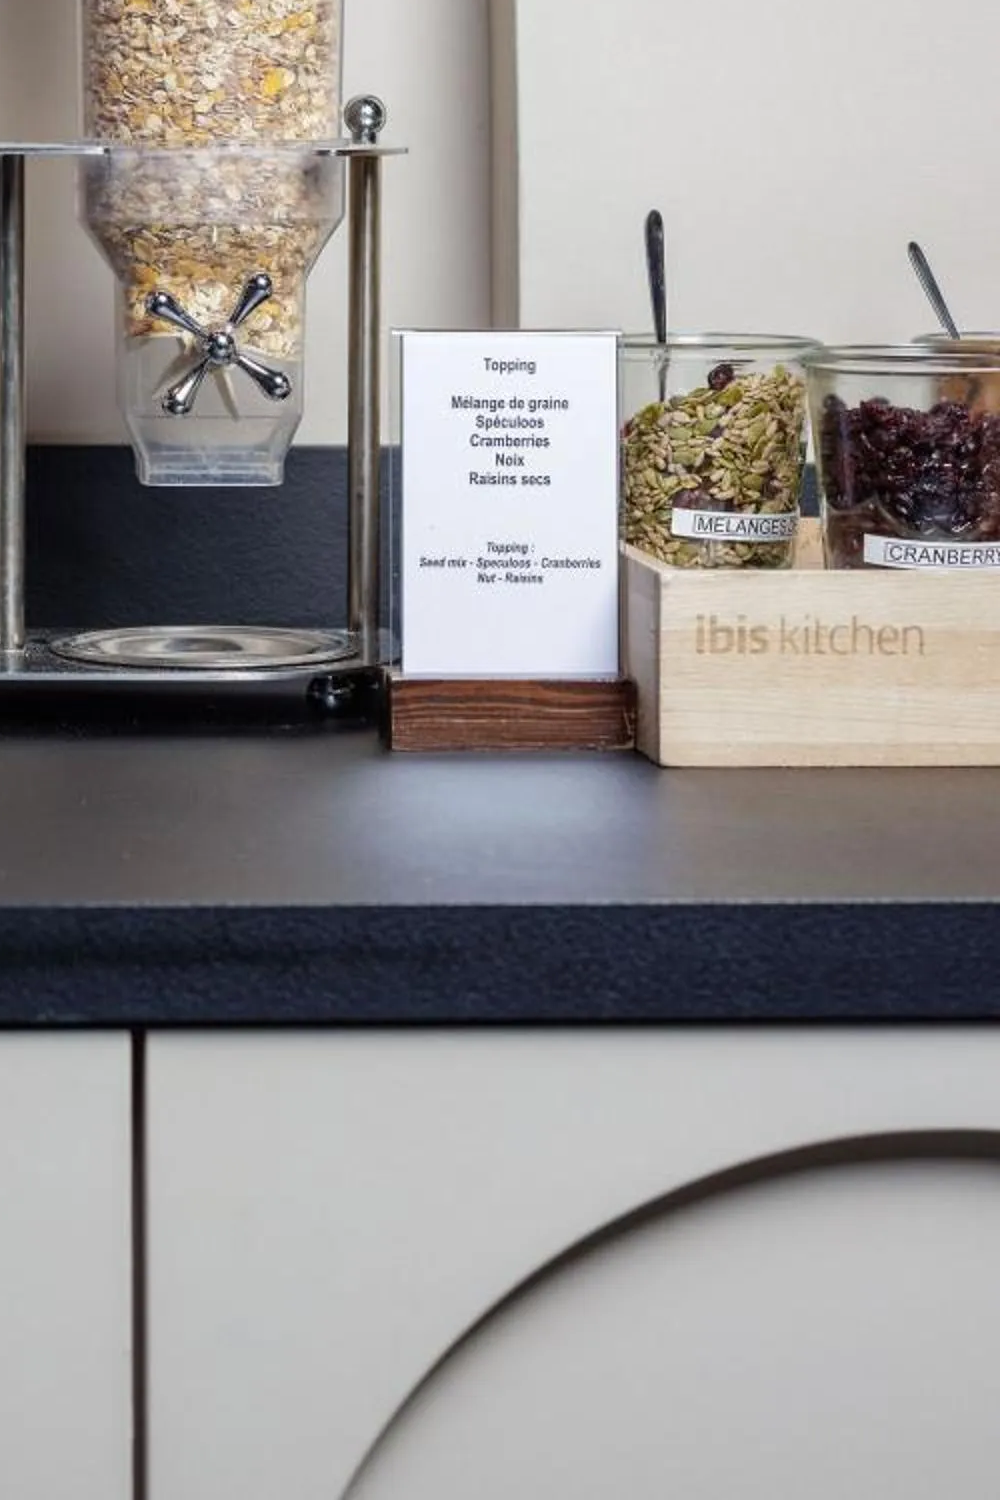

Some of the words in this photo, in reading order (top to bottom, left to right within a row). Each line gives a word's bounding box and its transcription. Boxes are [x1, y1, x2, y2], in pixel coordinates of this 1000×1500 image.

[483, 357, 536, 375] Topping
[451, 395, 505, 413] Mélange
[508, 396, 525, 410] de
[528, 396, 569, 413] graine
[475, 414, 545, 431] Spéculoos
[495, 452, 525, 467] Noix
[469, 471, 517, 486] Raisins
[521, 475, 551, 486] secs
[697, 517, 786, 535] MELANGES
[487, 541, 528, 555] Topping
[477, 572, 498, 584] Nut
[504, 572, 544, 584] Raisins
[695, 614, 769, 655] ibis
[780, 614, 925, 655] kitchen
